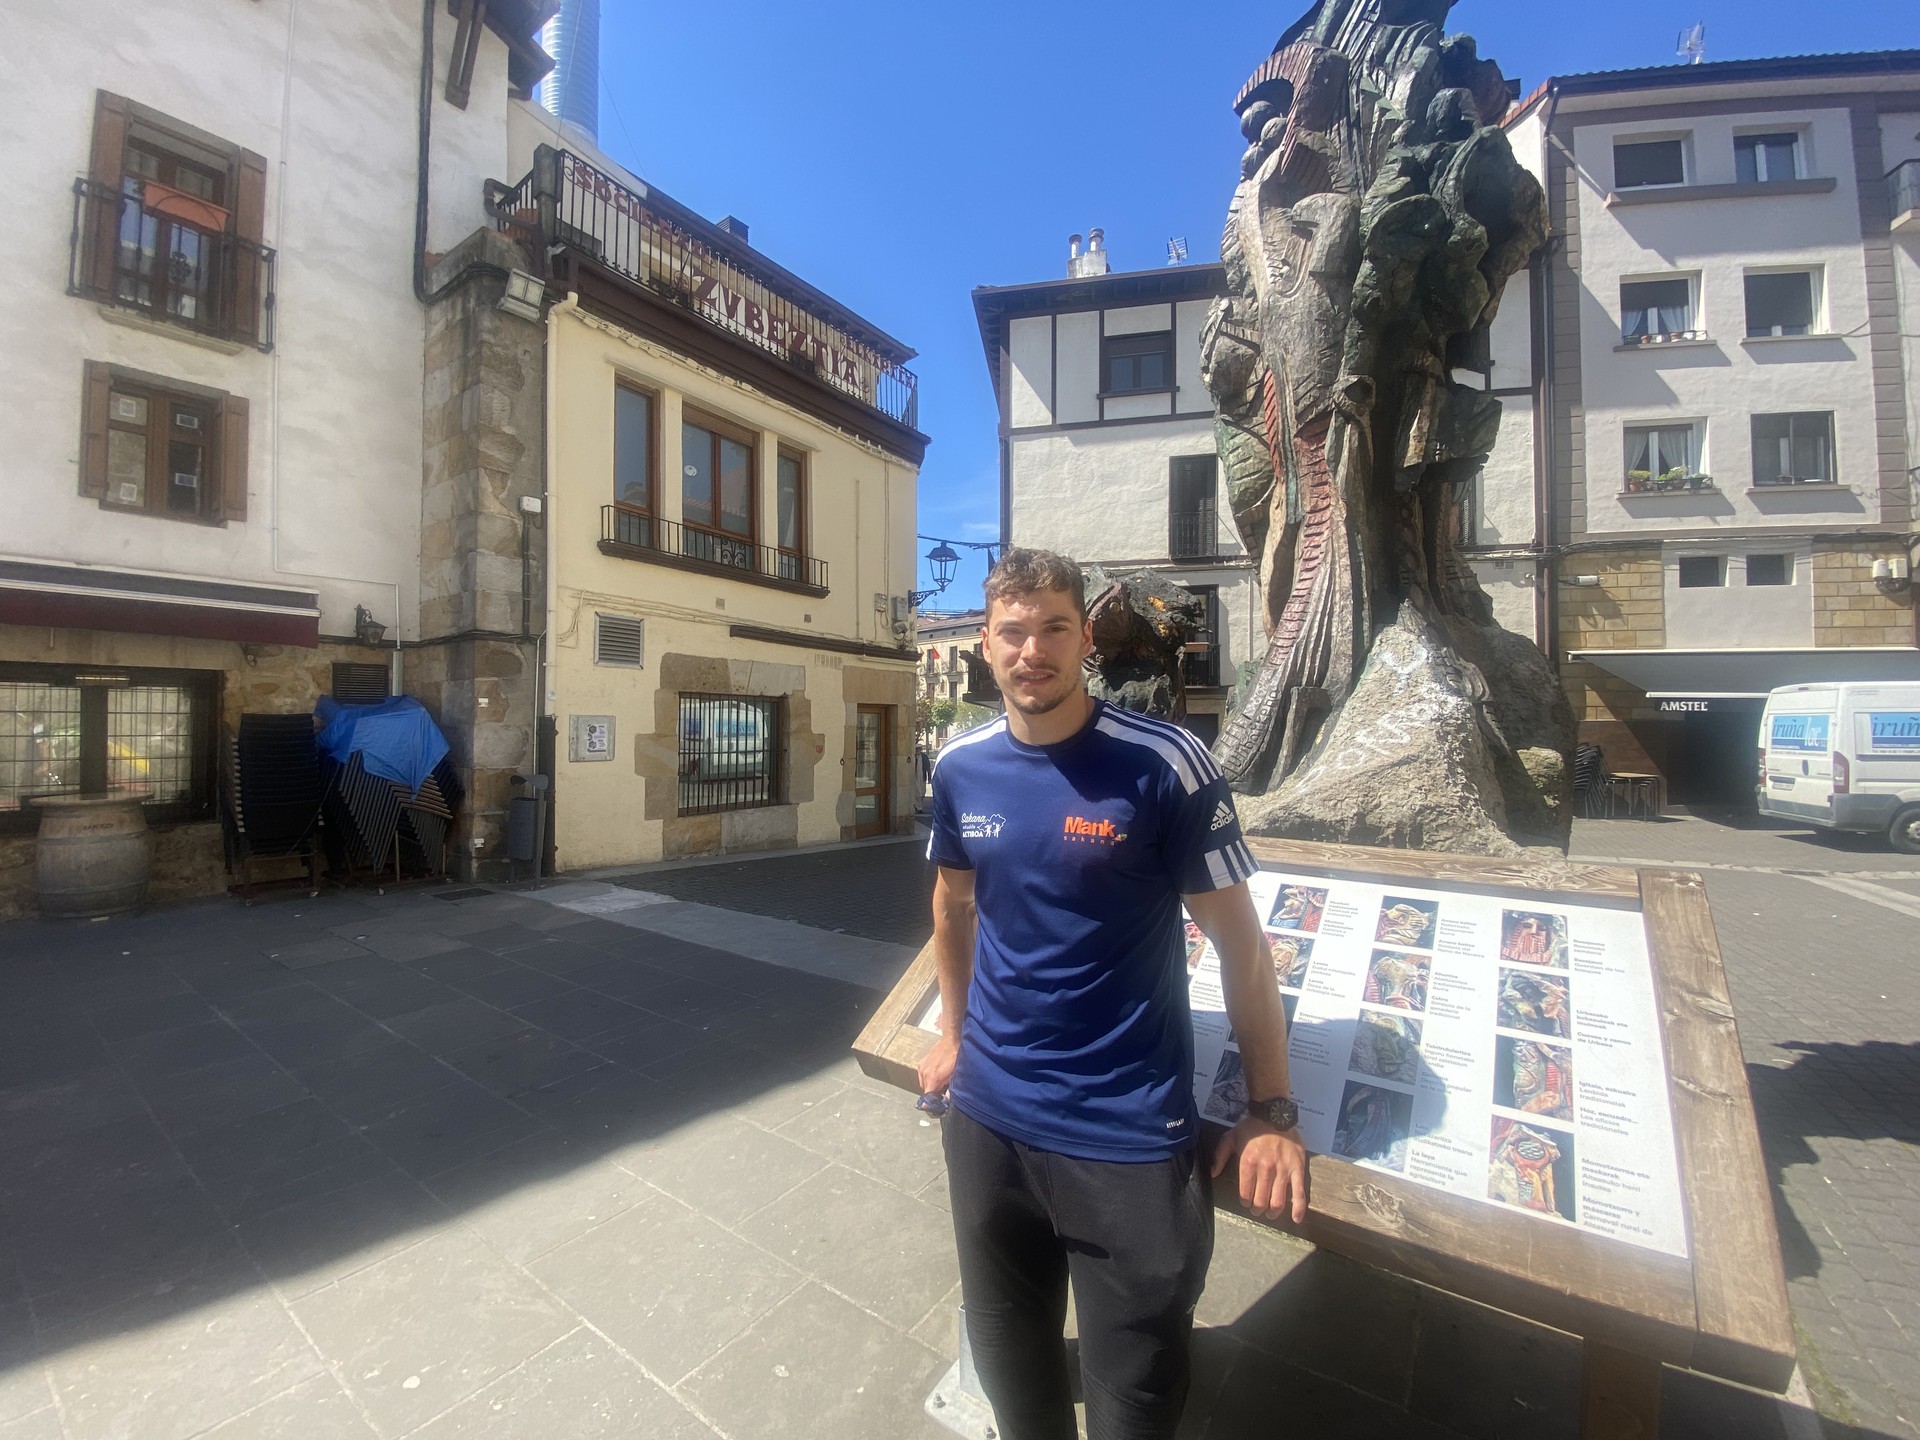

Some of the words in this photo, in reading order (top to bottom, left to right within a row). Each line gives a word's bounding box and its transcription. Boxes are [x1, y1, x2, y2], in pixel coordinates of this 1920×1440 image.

[1659, 701, 1706, 711] AMSTEL
[1064, 816, 1116, 838] Mank
[1210, 812, 1234, 831] adidas
[1063, 835, 1115, 846] sakana
[1580, 1113, 1593, 1121] Los
[1595, 1117, 1620, 1126] oficios
[1580, 1120, 1629, 1136] tradicionales
[1410, 1164, 1446, 1178] representa
[1454, 1169, 1468, 1177] que
[1582, 1166, 1619, 1179] maskarak
[1409, 1171, 1446, 1186] agricultura
[1582, 1173, 1620, 1187] Altsasuko
[1583, 1212, 1618, 1227] Carnaval
[1621, 1223, 1640, 1233] rural
[1583, 1220, 1615, 1234] Alsasua
